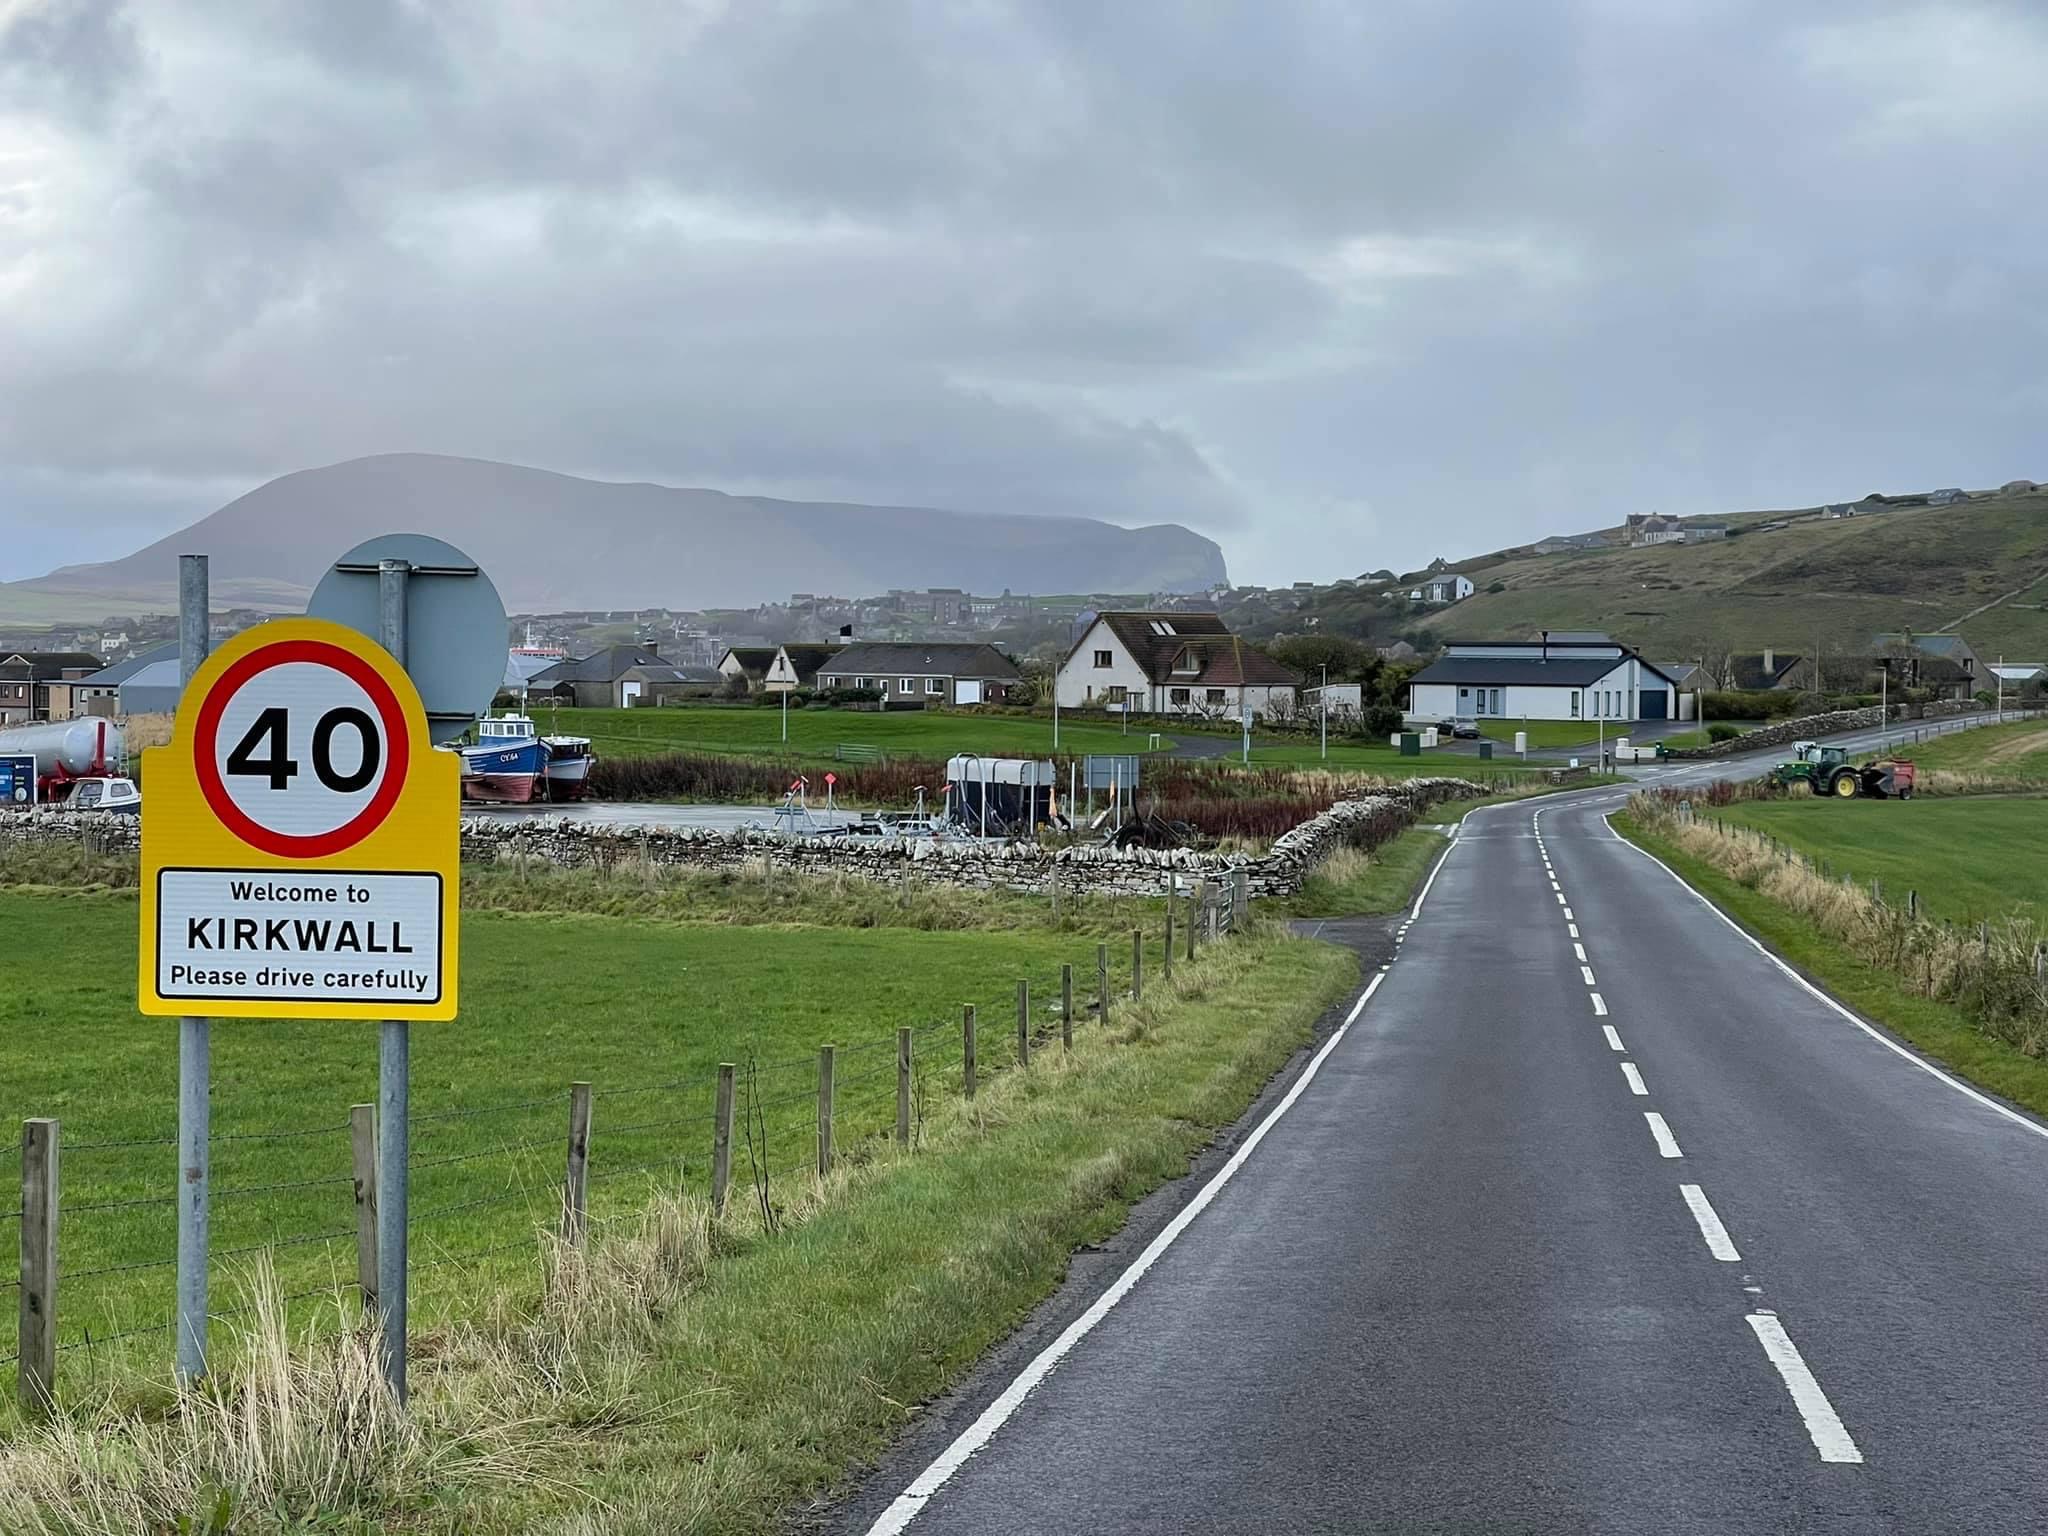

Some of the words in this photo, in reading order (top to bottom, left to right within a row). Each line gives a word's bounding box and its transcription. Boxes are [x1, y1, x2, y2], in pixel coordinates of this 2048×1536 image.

[226, 706, 381, 793] 40
[230, 881, 338, 903] Welcome
[346, 884, 370, 903] to
[187, 917, 414, 953] KIRKWALL
[171, 965, 247, 986] Please
[255, 966, 315, 988] drive
[323, 968, 429, 993] carefully
